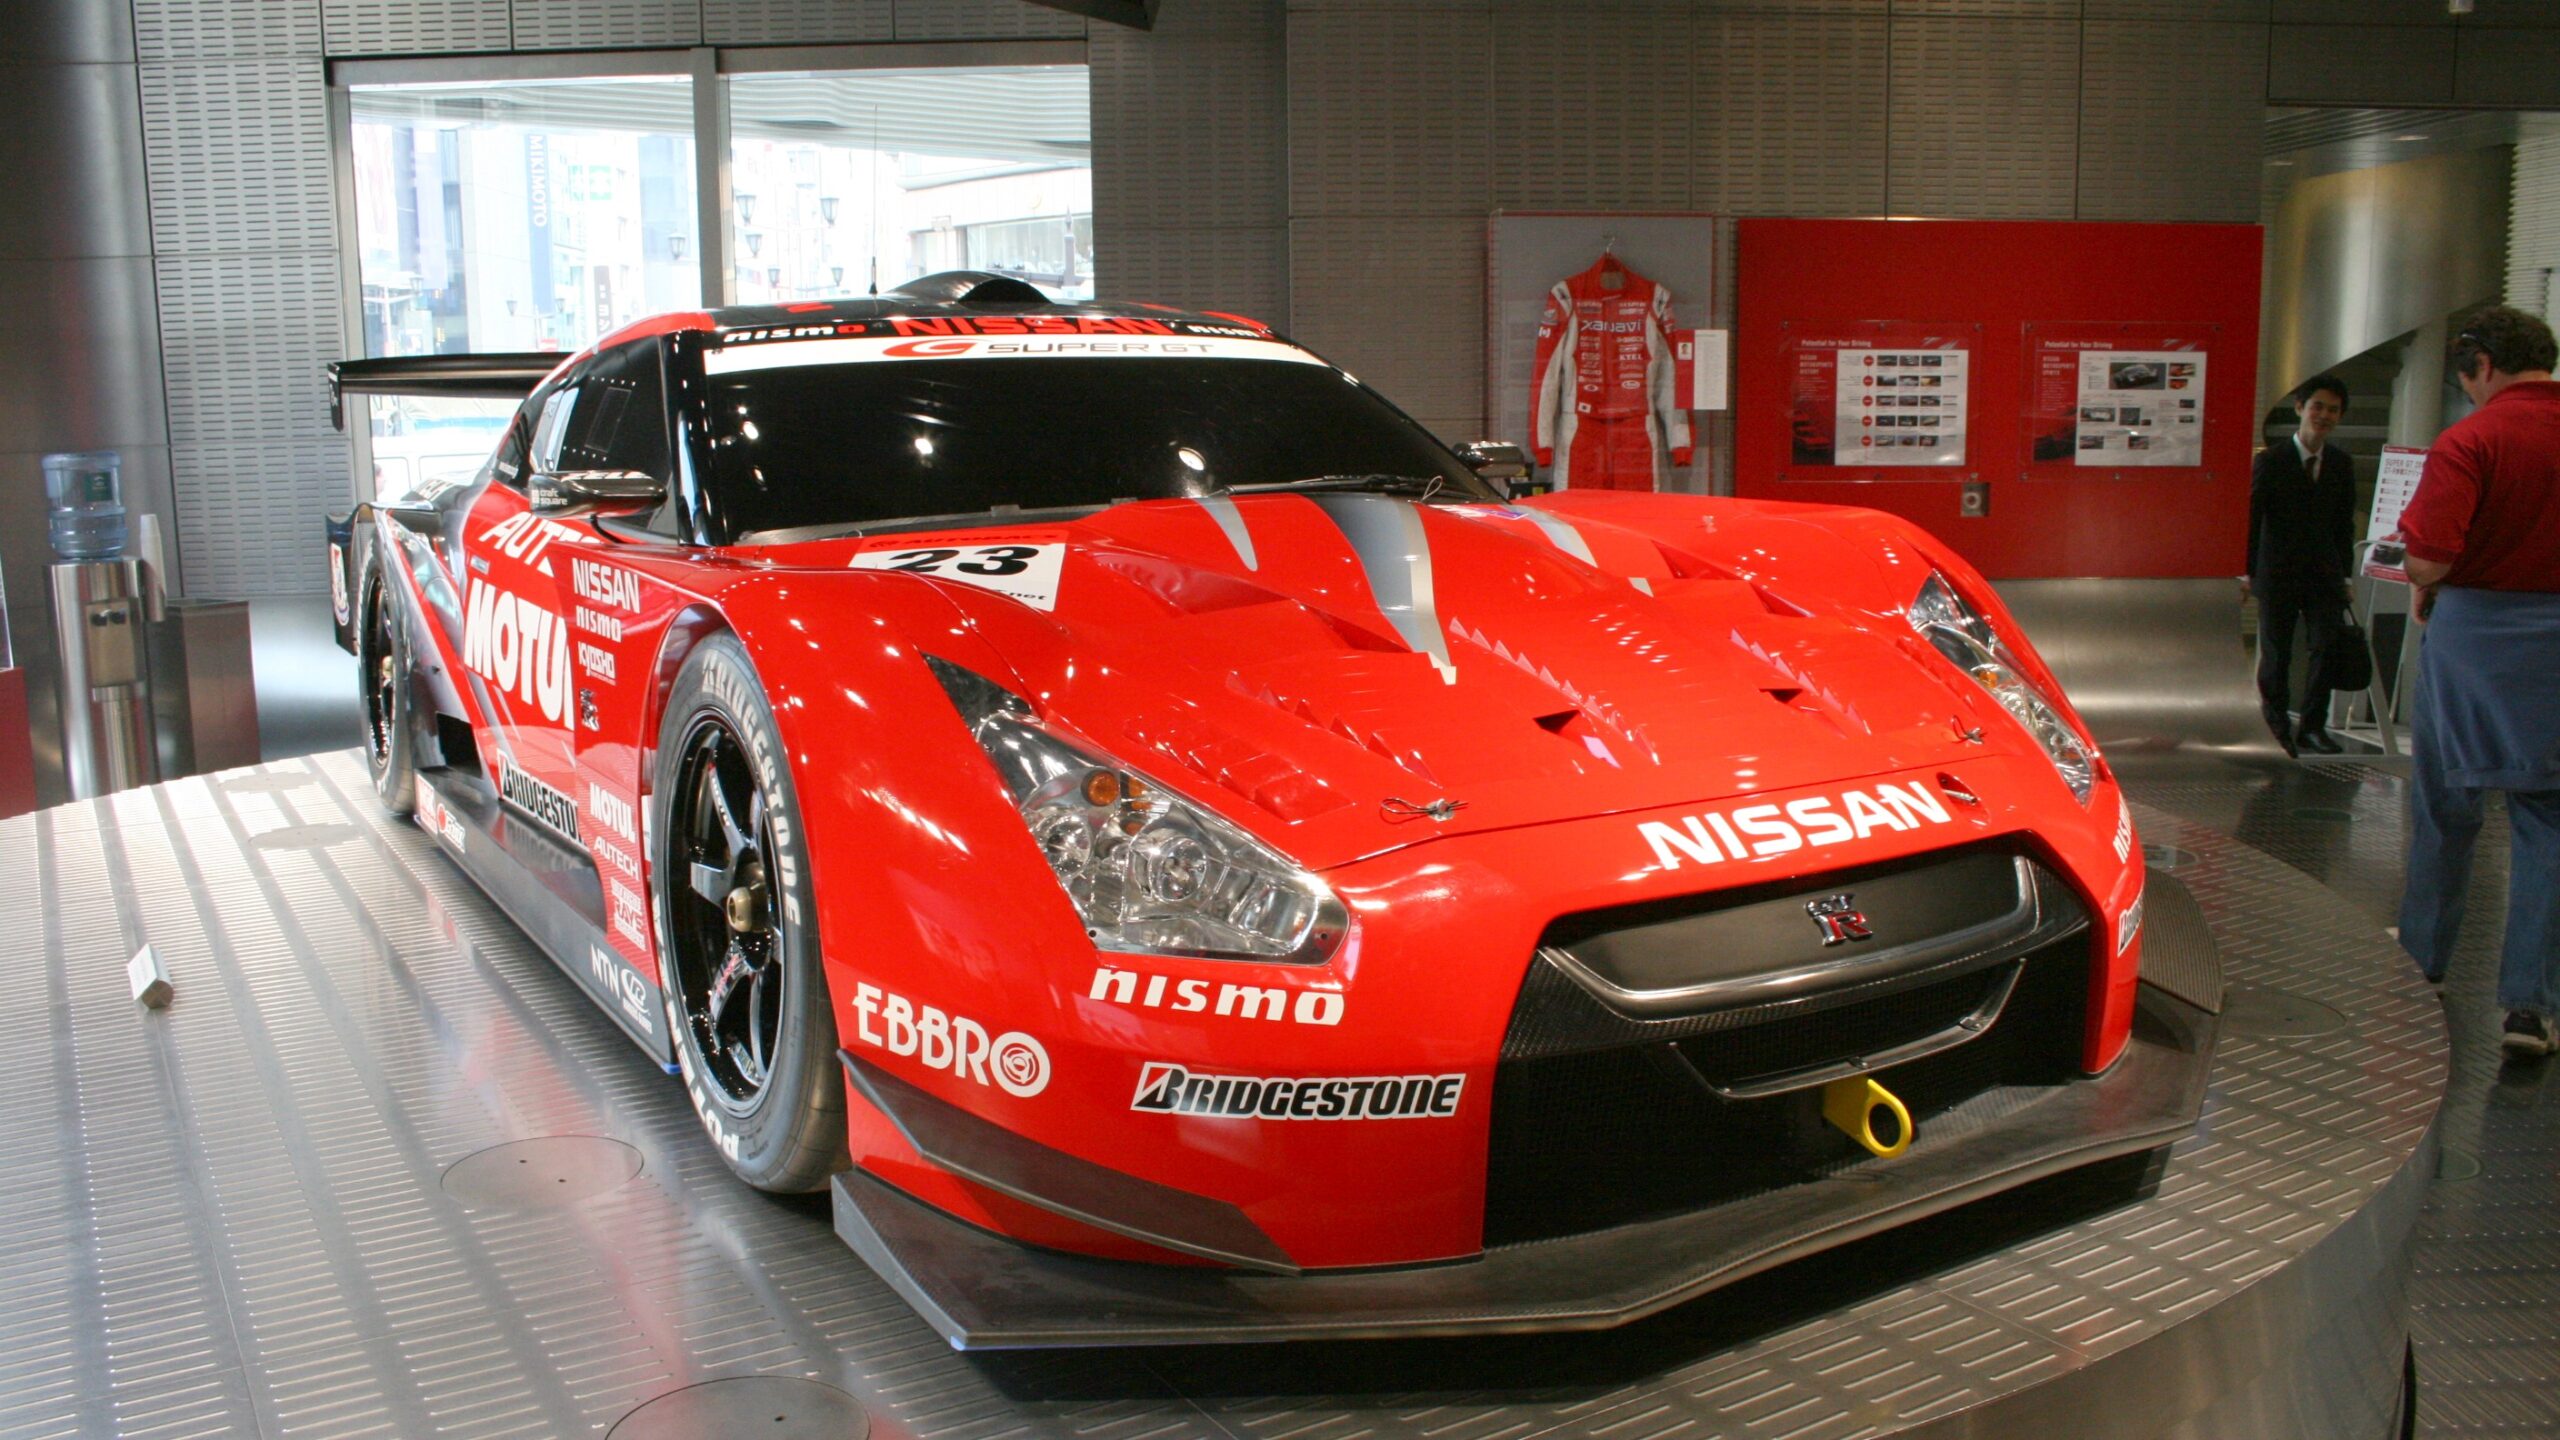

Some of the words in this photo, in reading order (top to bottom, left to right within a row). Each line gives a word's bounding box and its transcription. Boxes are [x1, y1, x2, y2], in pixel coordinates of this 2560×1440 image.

[528, 134, 548, 228] MIKIMOTO
[723, 324, 867, 343] nismo
[890, 316, 1175, 336] NISSAN
[987, 343, 1149, 354] SUPER
[1160, 343, 1214, 353] GT
[571, 557, 641, 614] NISSAN
[887, 546, 1041, 576] 23
[575, 604, 622, 643] nismo
[589, 781, 636, 844] MOTUL
[1637, 780, 1953, 870] NISSAN
[593, 836, 640, 881] AUTECH
[590, 943, 620, 999] NTN
[1088, 967, 1345, 1027] nismo
[851, 981, 1052, 1098] EBBRO
[1131, 1062, 1465, 1121] BRIDGESTONE
